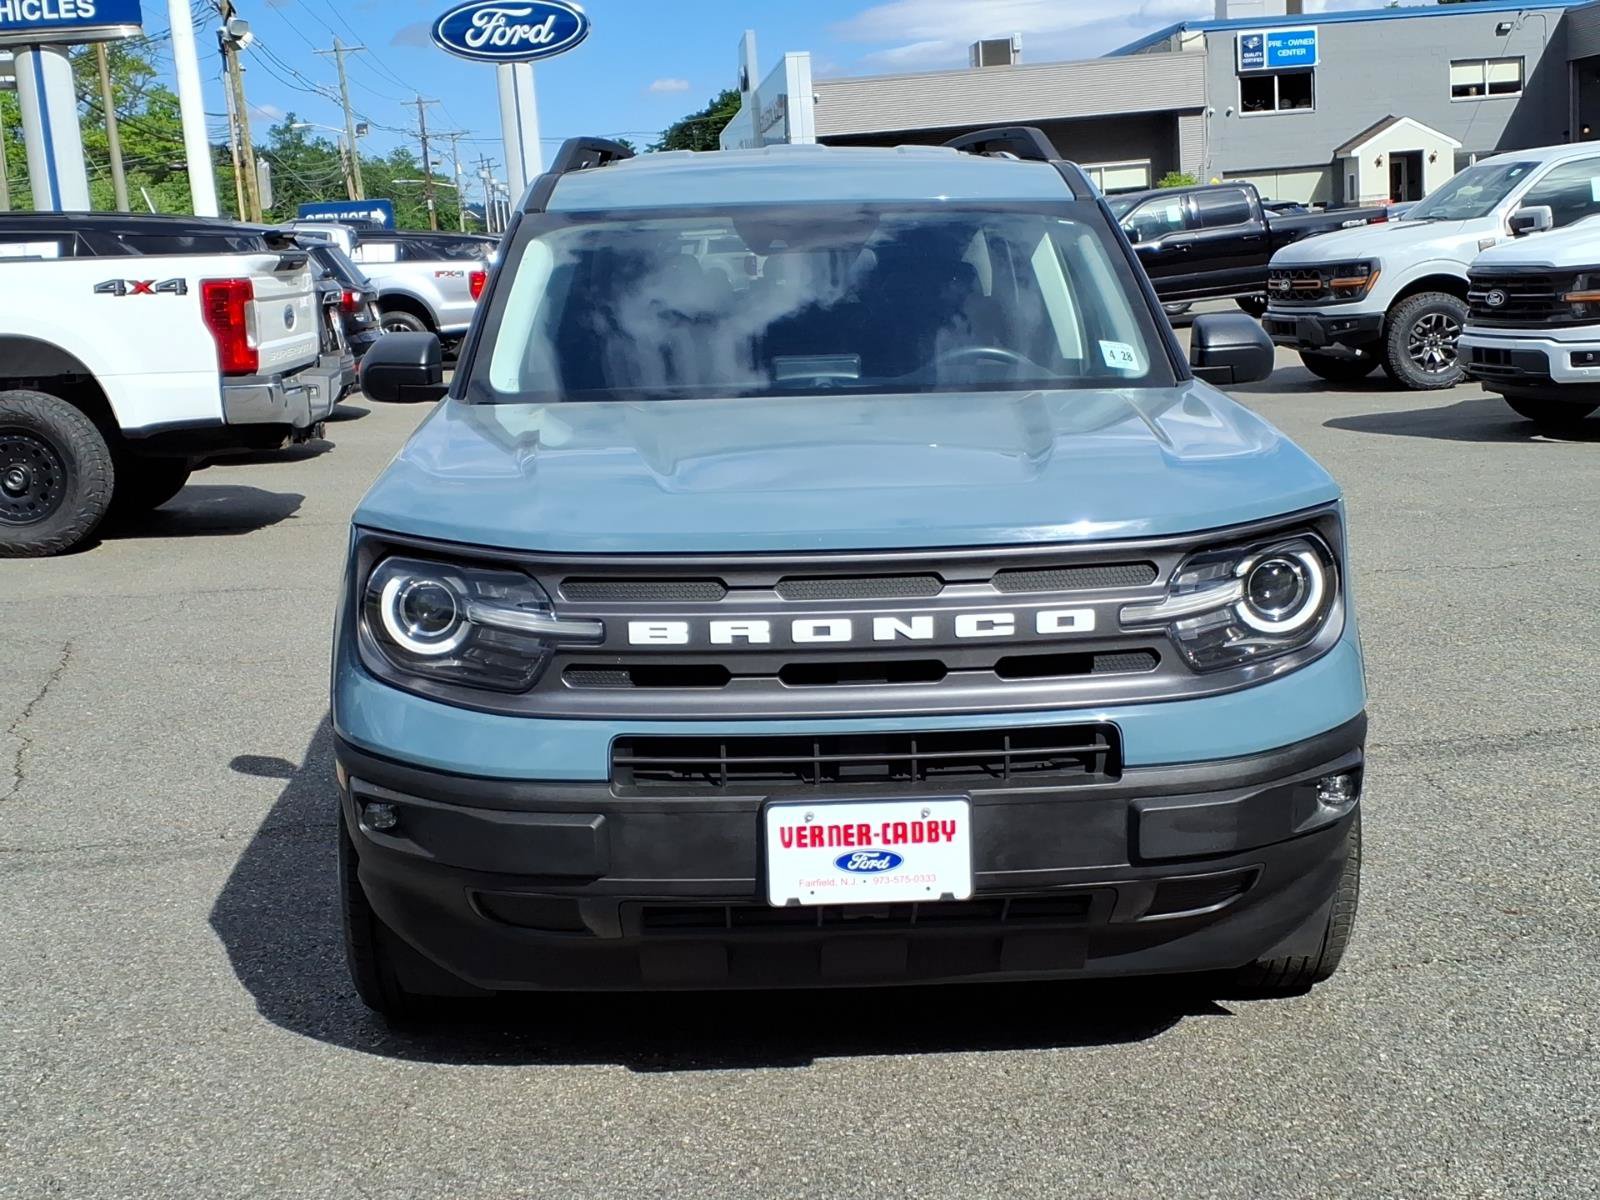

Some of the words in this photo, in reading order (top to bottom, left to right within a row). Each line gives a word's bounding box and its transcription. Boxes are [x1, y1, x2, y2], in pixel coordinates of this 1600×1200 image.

[465, 8, 556, 47] Ford
[1268, 40, 1282, 48] PRE
[1287, 38, 1315, 46] OWNED
[1277, 48, 1306, 57] CENTER
[1121, 351, 1133, 361] 28
[628, 608, 1096, 645] BRONCO
[779, 820, 956, 849] VERNER-CADBY
[847, 851, 890, 870] Ford
[872, 874, 937, 886] 973-575-0333
